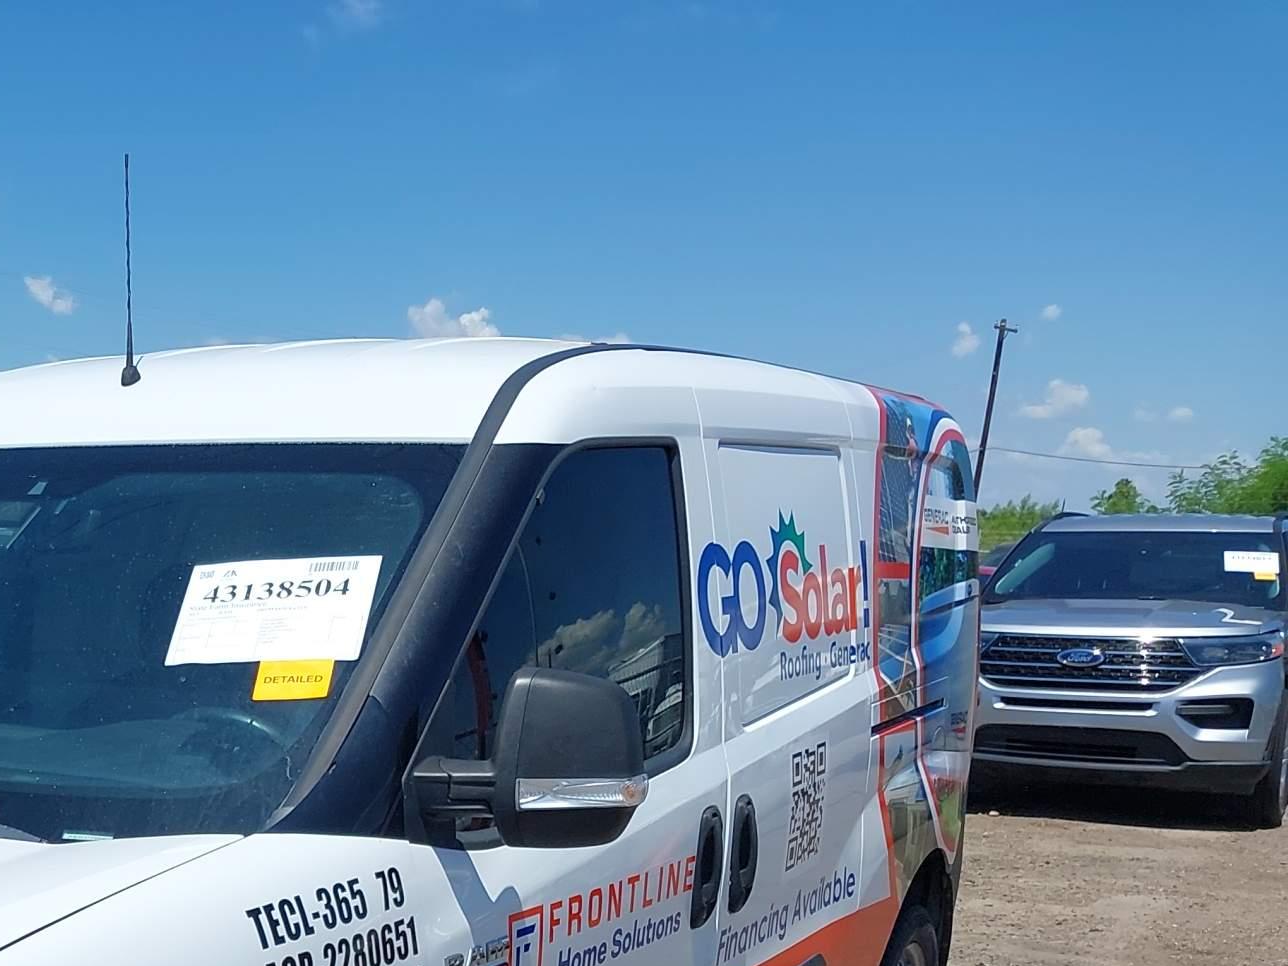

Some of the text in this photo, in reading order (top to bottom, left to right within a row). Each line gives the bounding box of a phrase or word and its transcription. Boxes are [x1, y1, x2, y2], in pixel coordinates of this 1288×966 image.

[202, 577, 351, 603] 43138504
[697, 539, 870, 658] GO Solar!
[263, 674, 324, 685] DETAILED
[780, 641, 870, 681] Roofing Generac
[245, 867, 405, 950] TECL-365 79
[549, 855, 696, 943] FRONTLINE
[716, 866, 857, 966] Financing Available
[611, 911, 682, 959] Solutions
